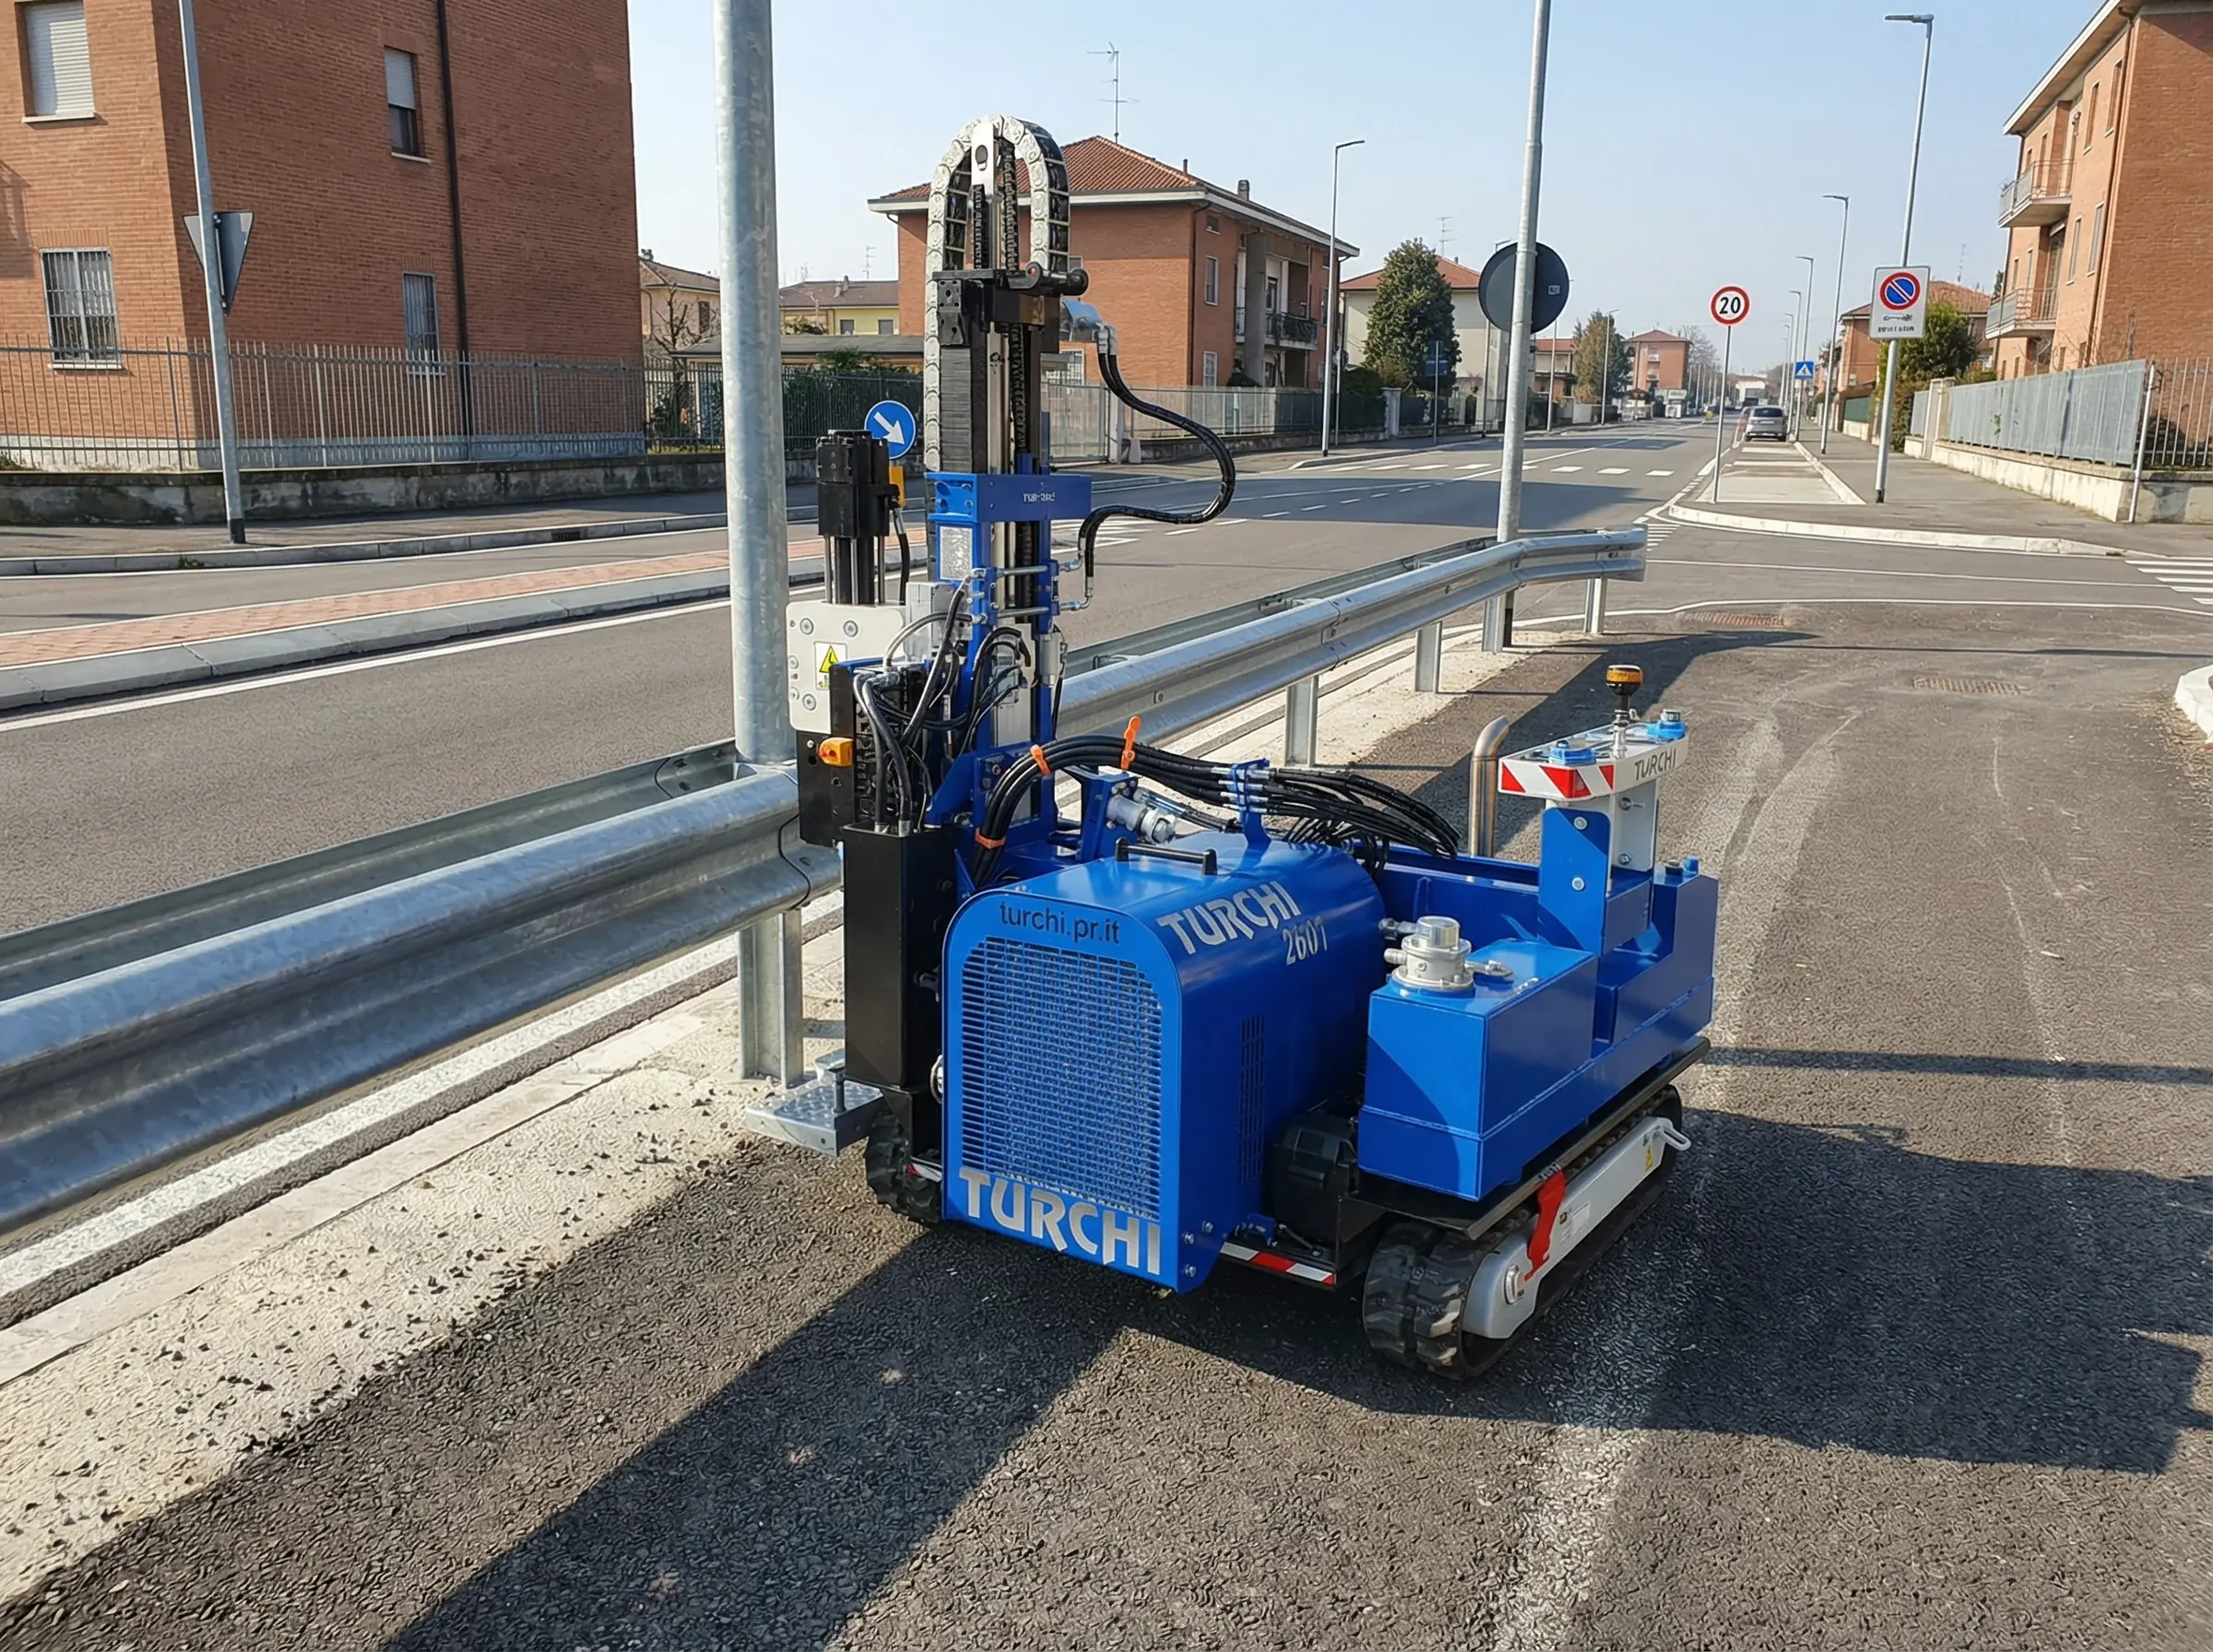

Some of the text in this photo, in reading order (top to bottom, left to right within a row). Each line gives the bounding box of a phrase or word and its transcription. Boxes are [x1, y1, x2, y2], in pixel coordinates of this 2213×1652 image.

[1720, 296, 1741, 314] 20
[1635, 748, 1676, 781] TURCHI
[1000, 901, 1120, 945] turchi.pr.it
[1156, 880, 1302, 955] TURCHI
[958, 1167, 1162, 1275] TURCHI
